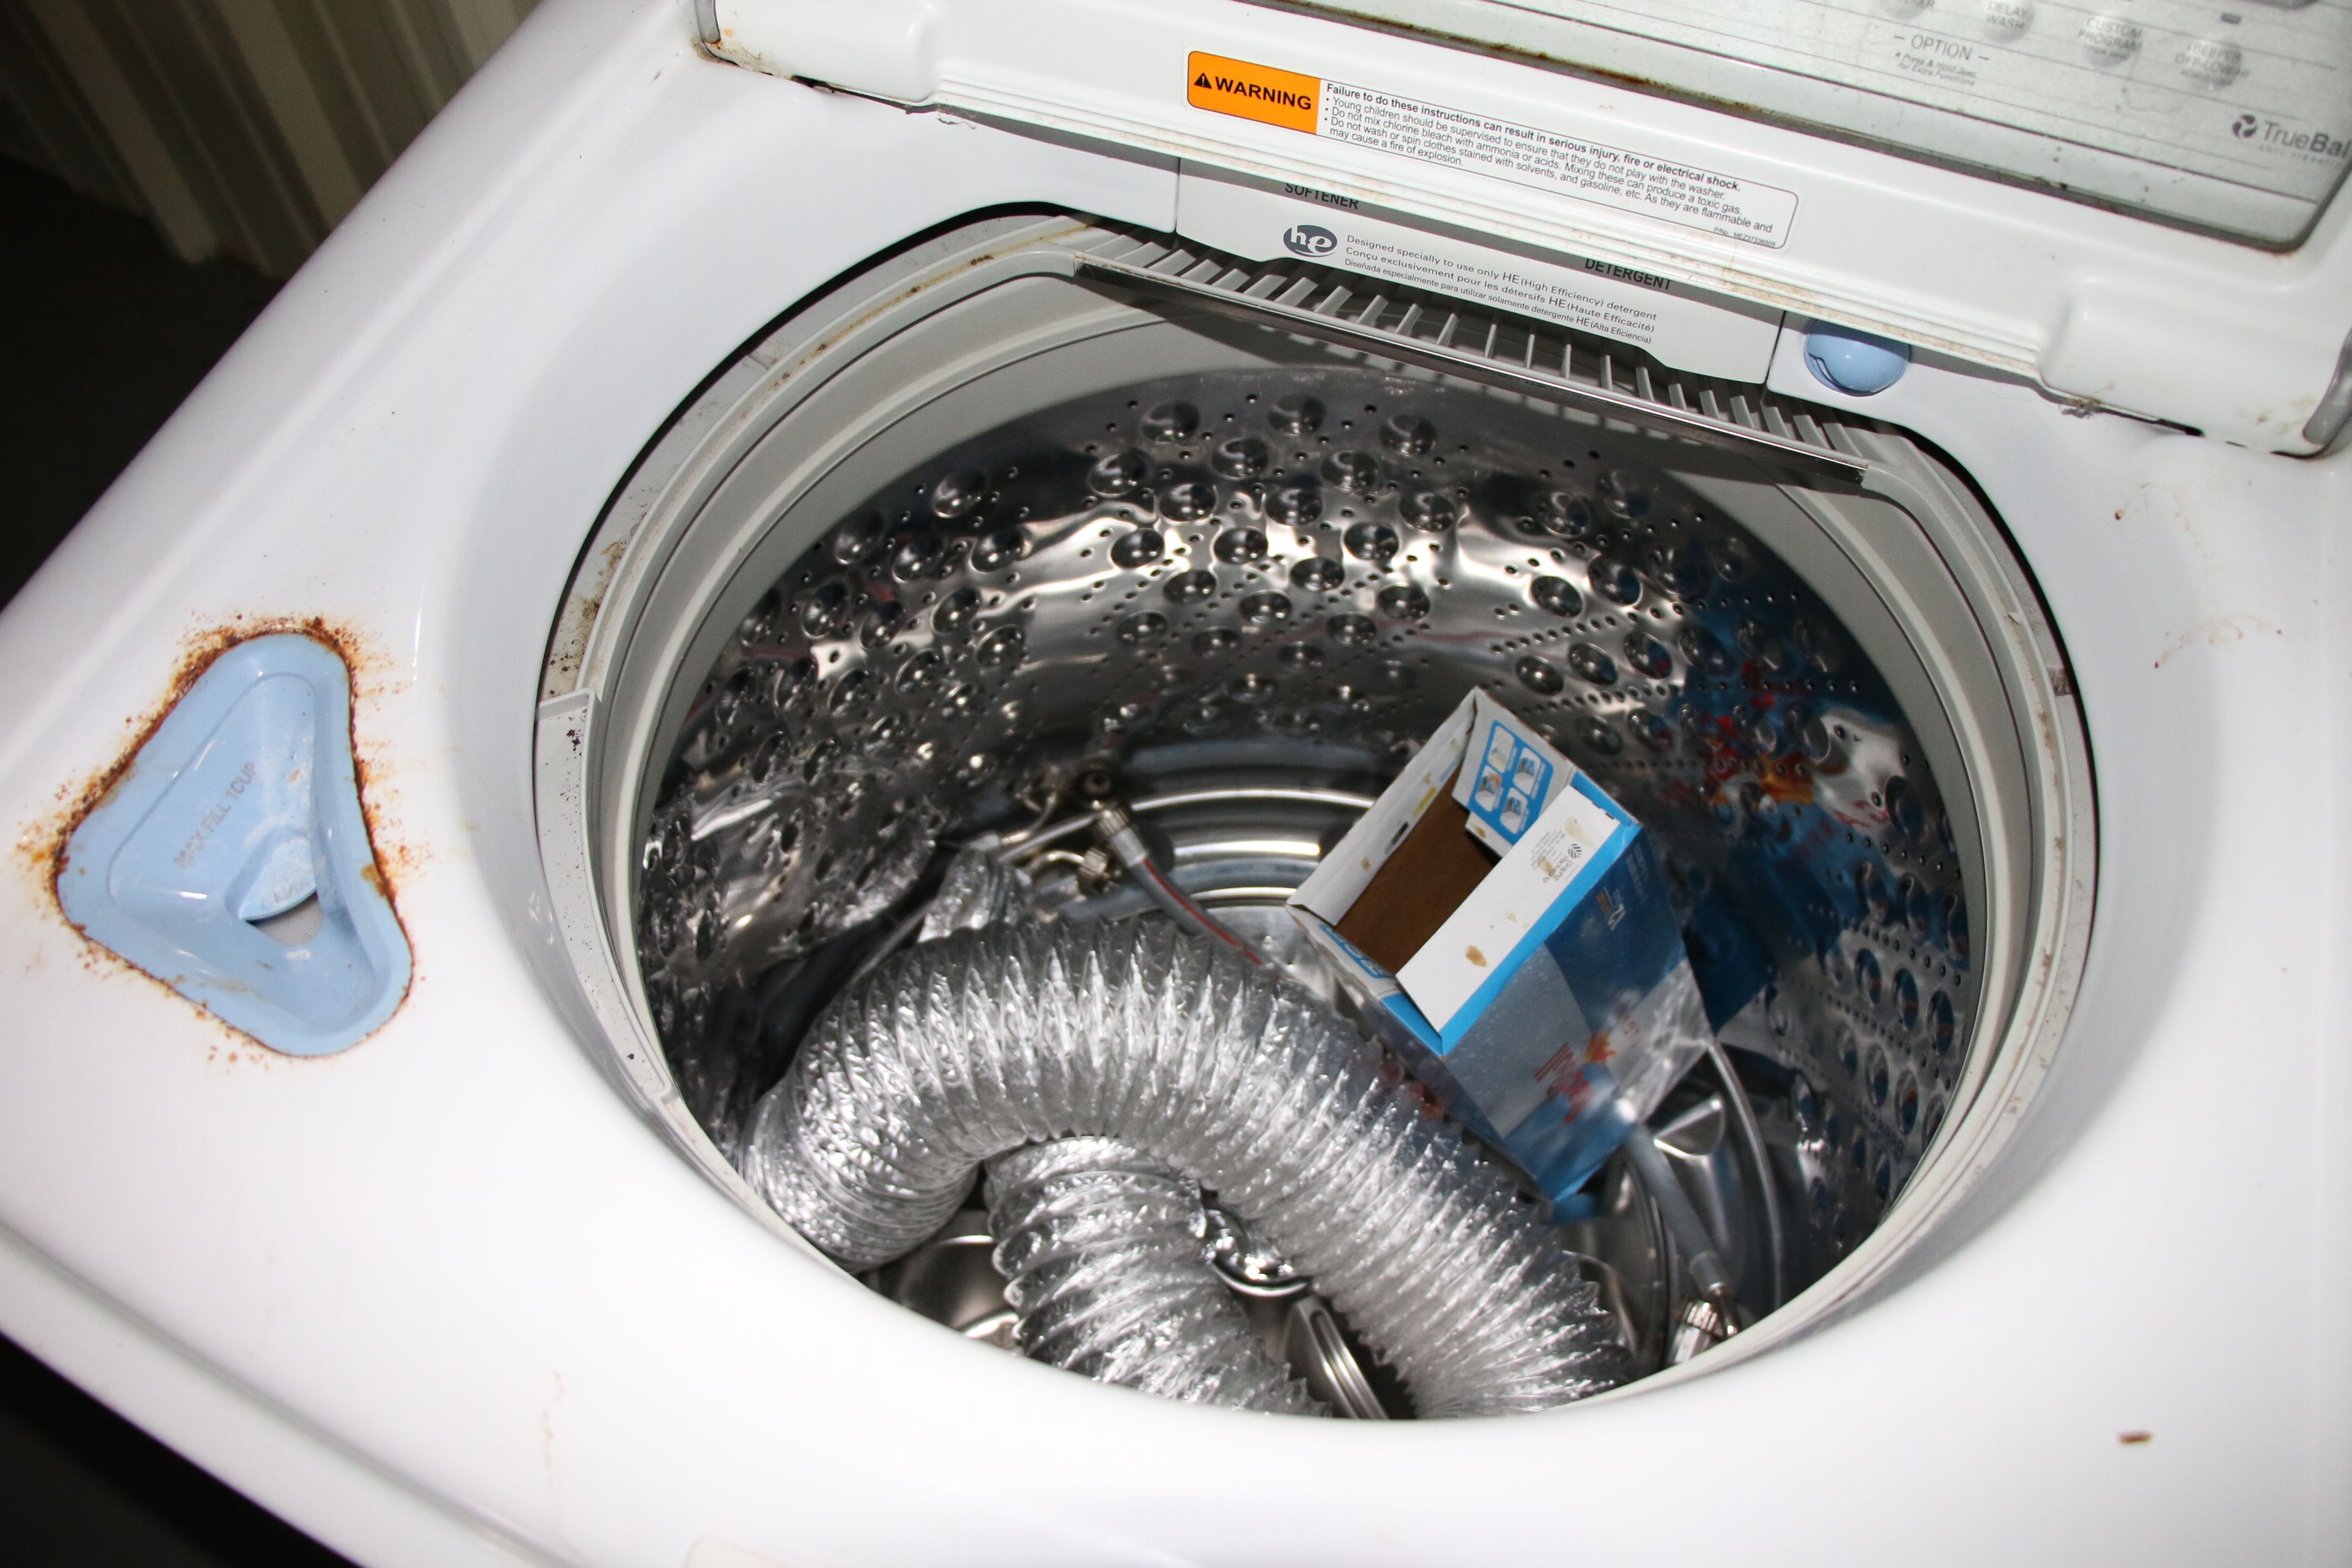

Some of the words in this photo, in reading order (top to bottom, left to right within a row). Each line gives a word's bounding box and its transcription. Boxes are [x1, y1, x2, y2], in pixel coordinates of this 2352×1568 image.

[1986, 14, 2024, 28] WASH
[1988, 1, 2027, 17] DELAY
[2086, 17, 2142, 37] CUSTOM
[1911, 34, 1972, 61] OPTION
[2077, 28, 2142, 52] PROGRAM
[1215, 76, 1311, 110] WARNING
[1326, 83, 1360, 99] Failure
[1363, 92, 1373, 103] to
[1375, 95, 1389, 106] do
[1391, 98, 1418, 113] these
[1421, 104, 1481, 128] instructions
[1483, 122, 1502, 133] can
[1504, 126, 1534, 141] result
[1536, 132, 1546, 143] in
[1548, 137, 1587, 153] serious
[1589, 145, 1620, 163] injury,
[1623, 153, 1641, 166] fire
[1643, 161, 1655, 170] or
[1656, 163, 1705, 182] electrical
[1706, 175, 1740, 191] shock.
[1329, 128, 1349, 141] may
[1351, 133, 1379, 146] cause
[1389, 140, 1404, 152] fire
[1406, 144, 1417, 155] of
[1417, 149, 1464, 166] explosion.
[1333, 96, 1362, 113] Young
[1364, 104, 1400, 122] children
[1402, 113, 1434, 131] should
[1435, 121, 1448, 132] be
[1450, 126, 1502, 144] supervised
[1504, 137, 1513, 147] to
[1514, 140, 1549, 156] ensure
[1550, 148, 1569, 164] that
[1571, 153, 1592, 168] they
[1593, 159, 1606, 173] do
[1608, 164, 1625, 175] not
[1625, 168, 1647, 182] play
[1649, 174, 1668, 185] with
[1671, 178, 1686, 190] the
[1689, 184, 1725, 199] washer.
[1331, 106, 1346, 118] Do
[1348, 112, 1362, 122] not
[1364, 116, 1381, 126] mix
[1382, 120, 1420, 135] chlorine
[1422, 128, 1453, 143] bleach
[1455, 137, 1474, 148] with
[1476, 142, 1520, 159] ammonia
[1522, 153, 1533, 162] or
[1534, 157, 1561, 170] acids.
[1564, 162, 1596, 180] Mixing
[1598, 171, 1625, 185] these
[1626, 179, 1645, 190] can
[1646, 184, 1687, 201] produce
[1688, 195, 1695, 203] a
[1697, 195, 1720, 210] toxic
[1721, 204, 1741, 215] gas.
[1331, 116, 1344, 128] Do
[1346, 122, 1362, 132] not
[1363, 126, 1387, 138] wash
[1389, 132, 1400, 142] or
[1402, 135, 1421, 147] spin
[1423, 139, 1456, 155] clothes
[1458, 148, 1493, 163] stained
[1494, 157, 1514, 168] with
[1516, 162, 1557, 180] solvents,
[1560, 173, 1579, 184] and
[1580, 178, 1622, 196] gasoline,
[1625, 190, 1642, 200] etc.
[1644, 193, 1658, 204] As
[1660, 197, 1681, 211] they
[1682, 204, 1700, 214] are
[1701, 206, 1752, 228] flammable
[1753, 222, 1773, 233] and
[1285, 183, 1359, 210] SOFTENER
[1346, 246, 1378, 261] Conçu
[1380, 257, 1455, 280] exclusivement
[1456, 275, 1482, 286] pour
[1484, 280, 1498, 291] les
[1501, 286, 1545, 303] détersifs
[1603, 312, 1654, 333] Efficacité)
[1347, 235, 1394, 253] Designed
[1396, 248, 1441, 266] specially
[1443, 259, 1454, 268] to
[1456, 263, 1475, 273] use
[1477, 268, 1500, 280] only
[1551, 286, 1604, 308] Efficiency)
[1607, 302, 1657, 321] detergent
[1585, 259, 1671, 290] DETERGENT
[1344, 258, 1381, 273] Diseñada
[1382, 269, 1439, 288] especialmente
[1440, 283, 1458, 293] para
[1460, 288, 1487, 299] utilizar
[1487, 295, 1530, 311] solamente
[1531, 306, 1574, 323] detergente
[1611, 326, 1652, 345] Eficiencia)
[173, 830, 207, 868] MAX
[201, 804, 231, 832] FILL
